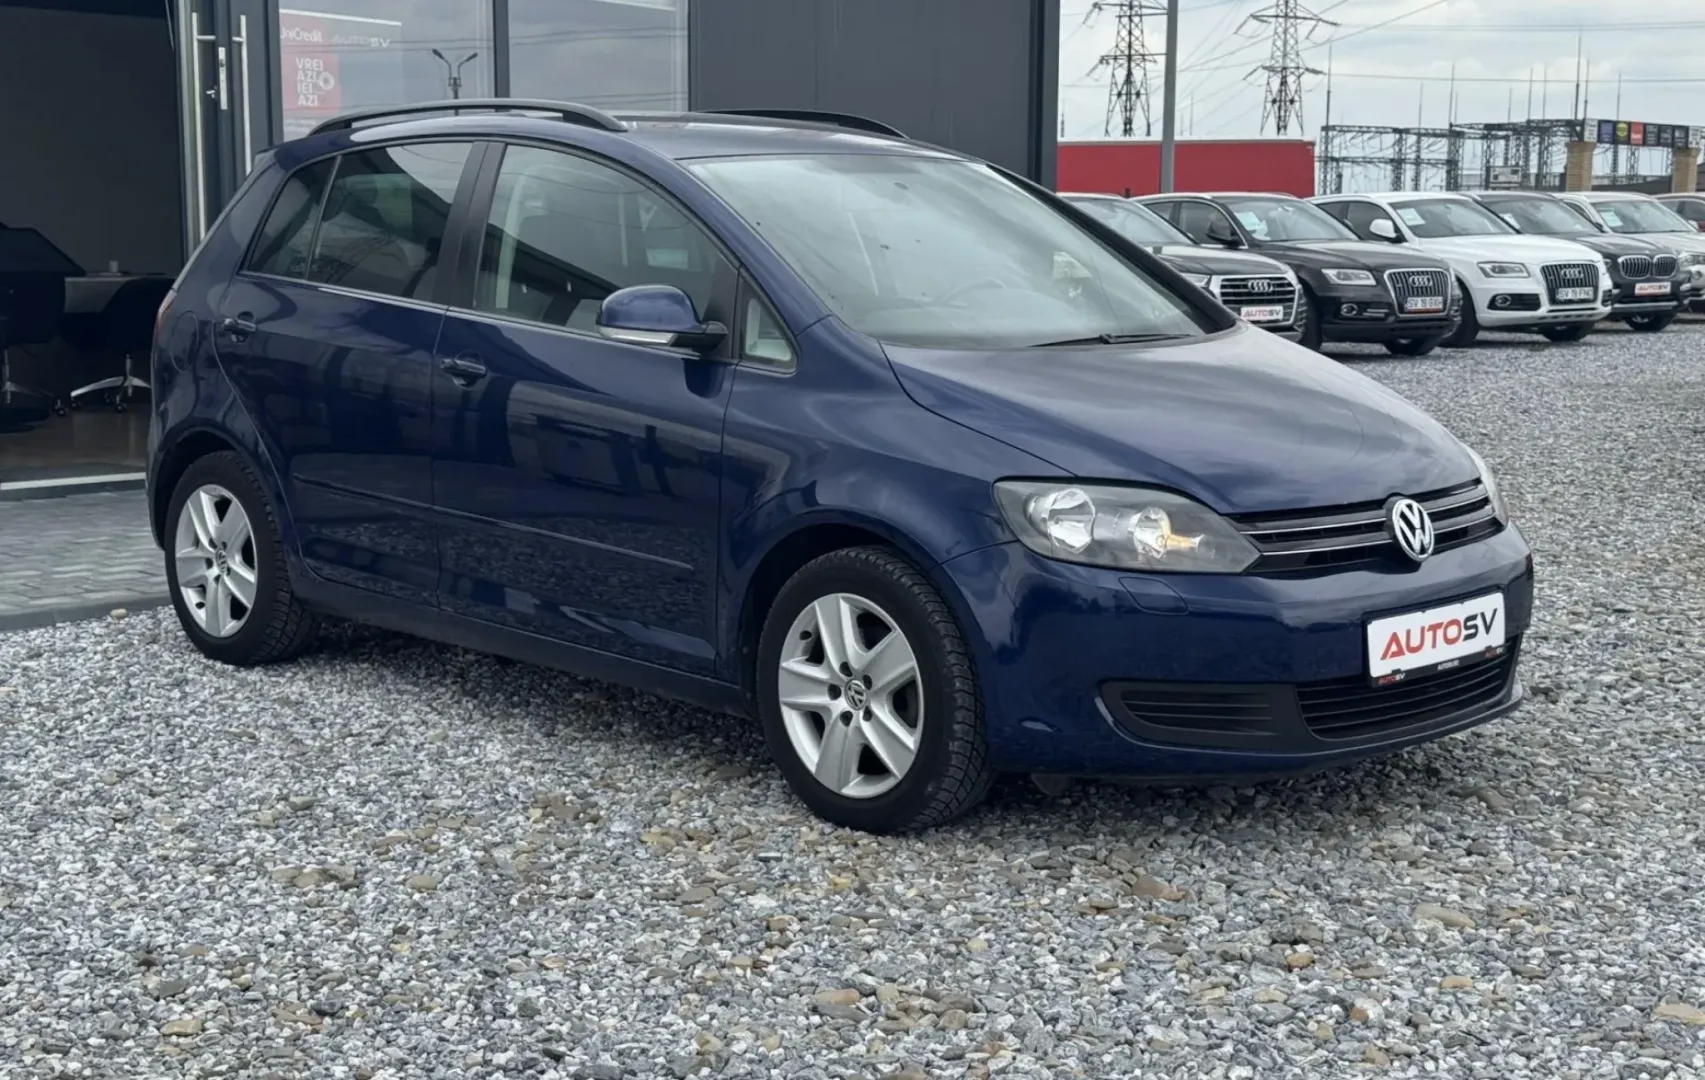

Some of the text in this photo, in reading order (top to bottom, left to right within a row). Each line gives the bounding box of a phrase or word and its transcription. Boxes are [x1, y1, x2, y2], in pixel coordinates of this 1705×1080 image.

[332, 34, 390, 47] AUTOSV
[296, 57, 323, 71] VREI
[297, 70, 317, 82] AZI
[297, 82, 313, 94] IEI
[298, 94, 318, 107] AZI
[1244, 309, 1281, 317] AUTOSV
[1380, 607, 1498, 661] AUTOSV
